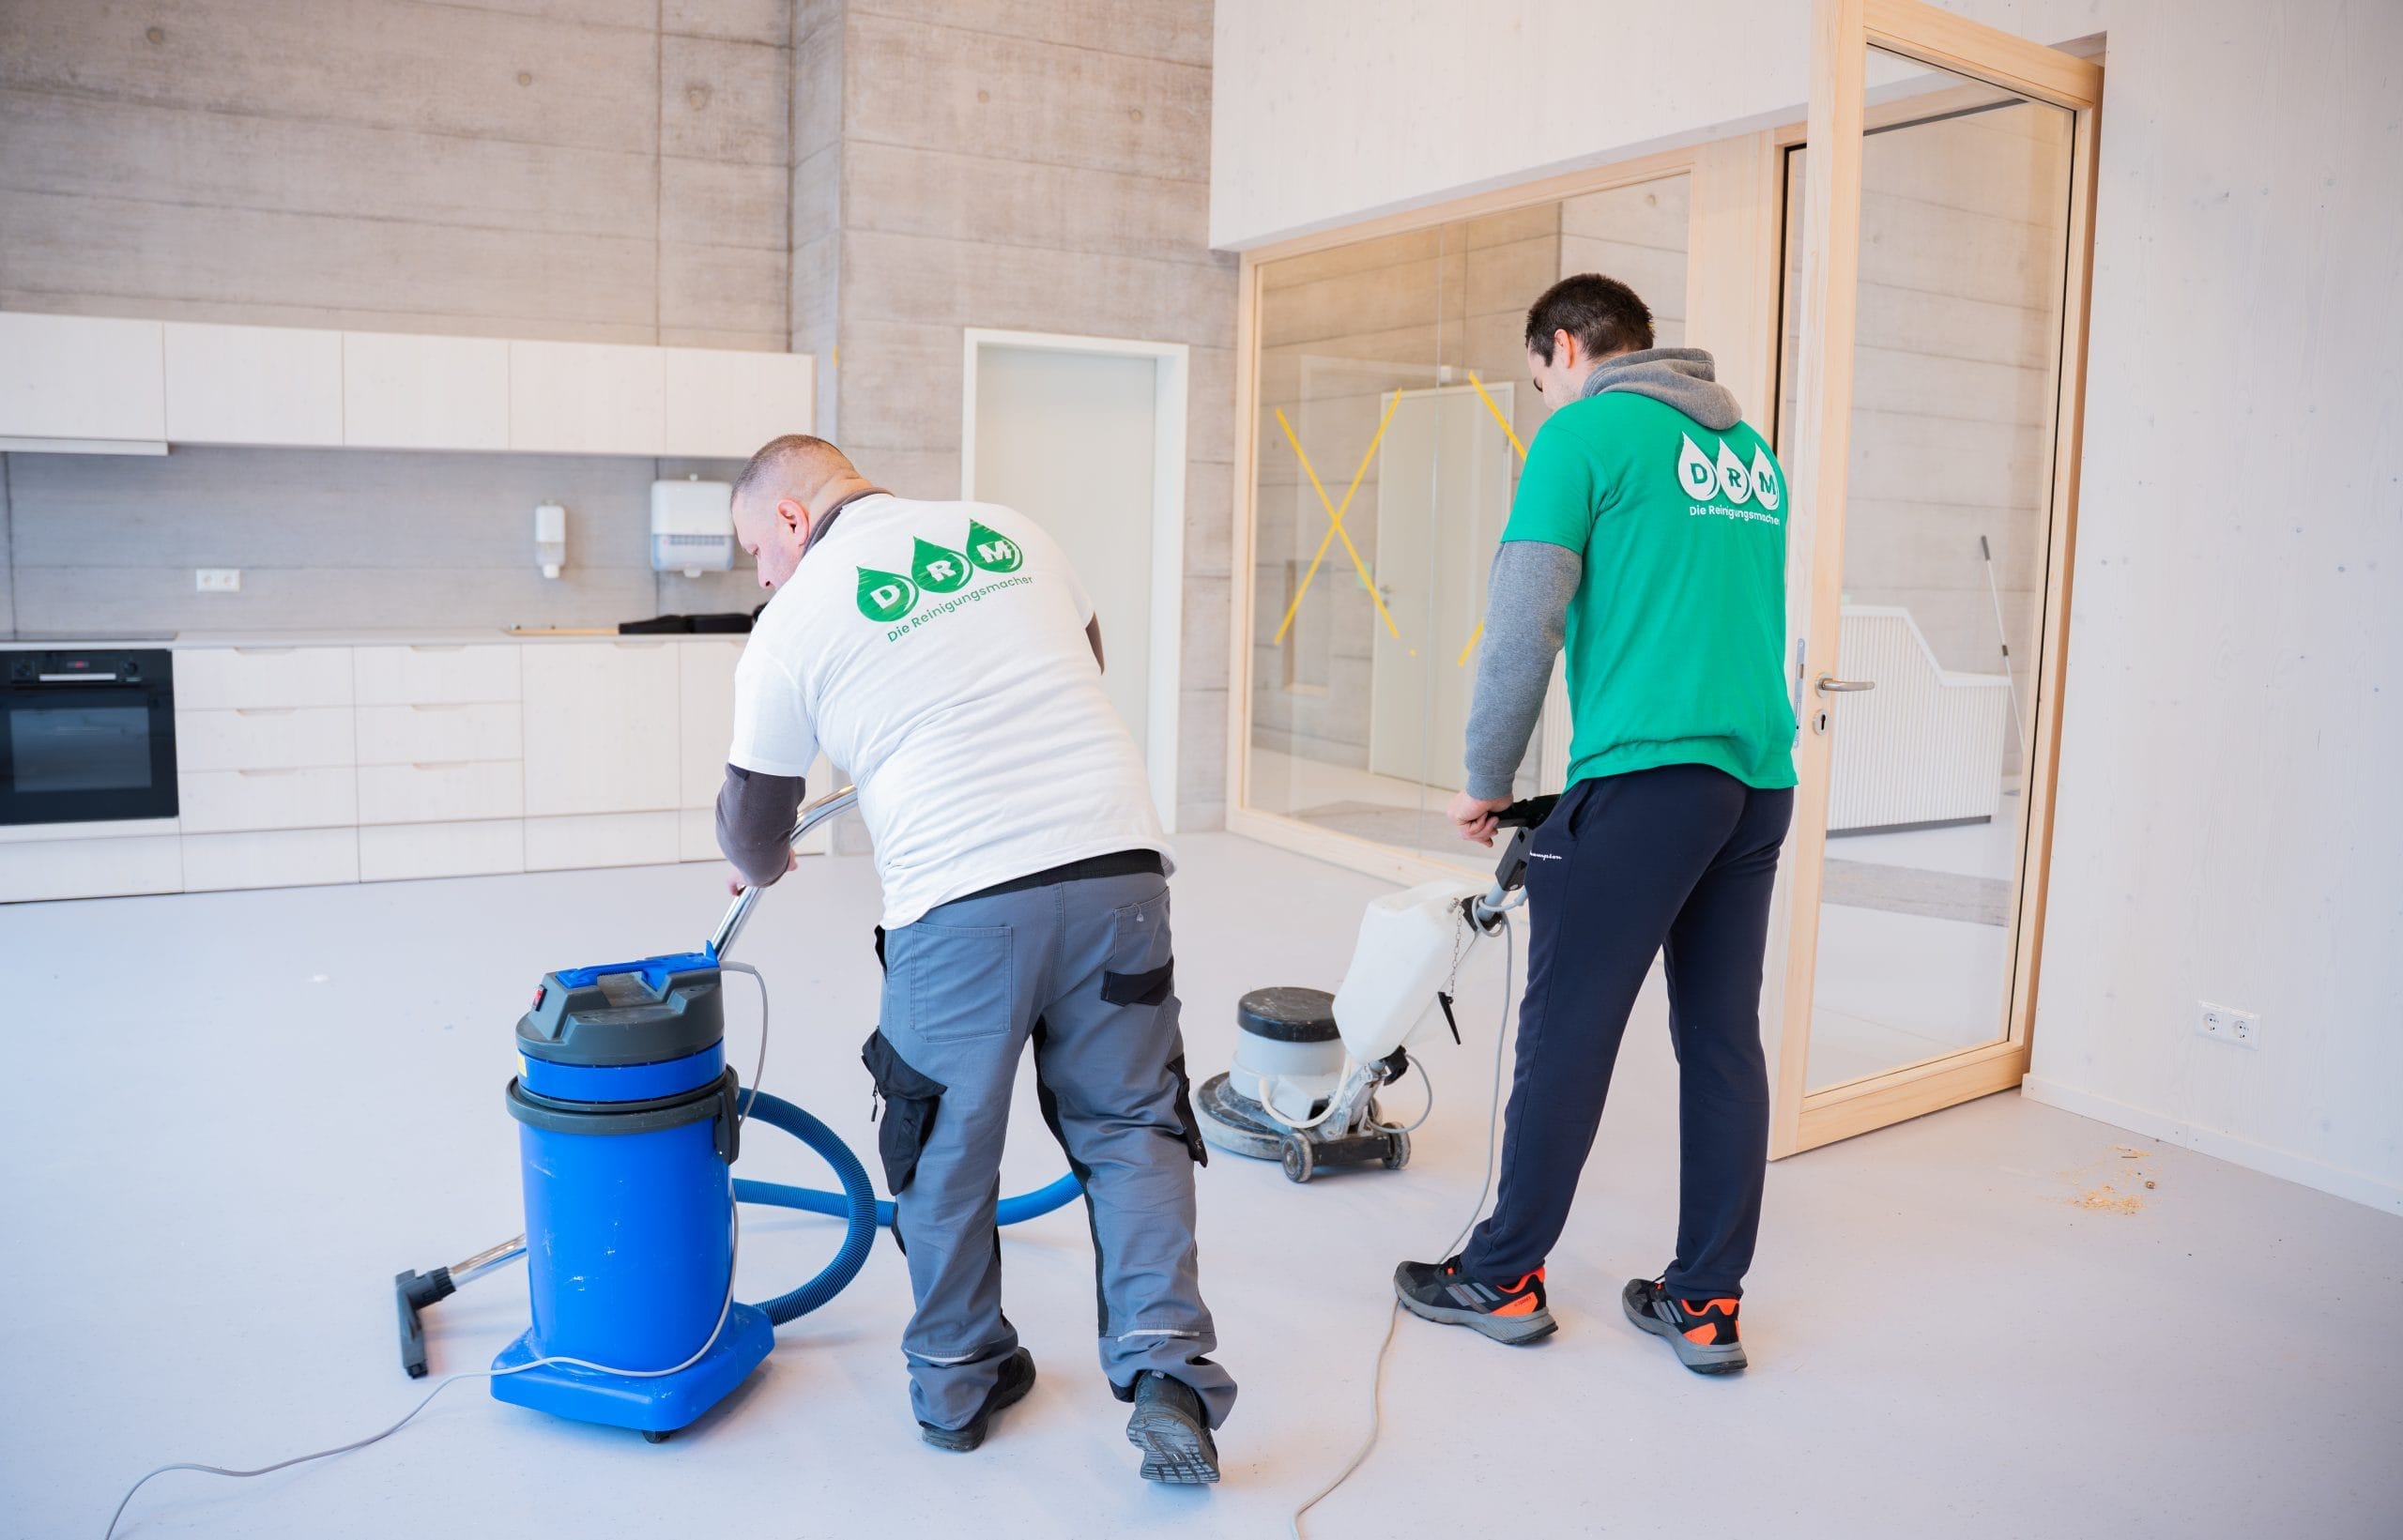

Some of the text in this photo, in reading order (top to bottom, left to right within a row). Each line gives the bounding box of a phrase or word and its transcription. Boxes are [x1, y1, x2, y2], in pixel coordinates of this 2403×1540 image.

[1690, 505, 1707, 515] Die
[887, 575, 1033, 643] Die Reinigungsmacher
